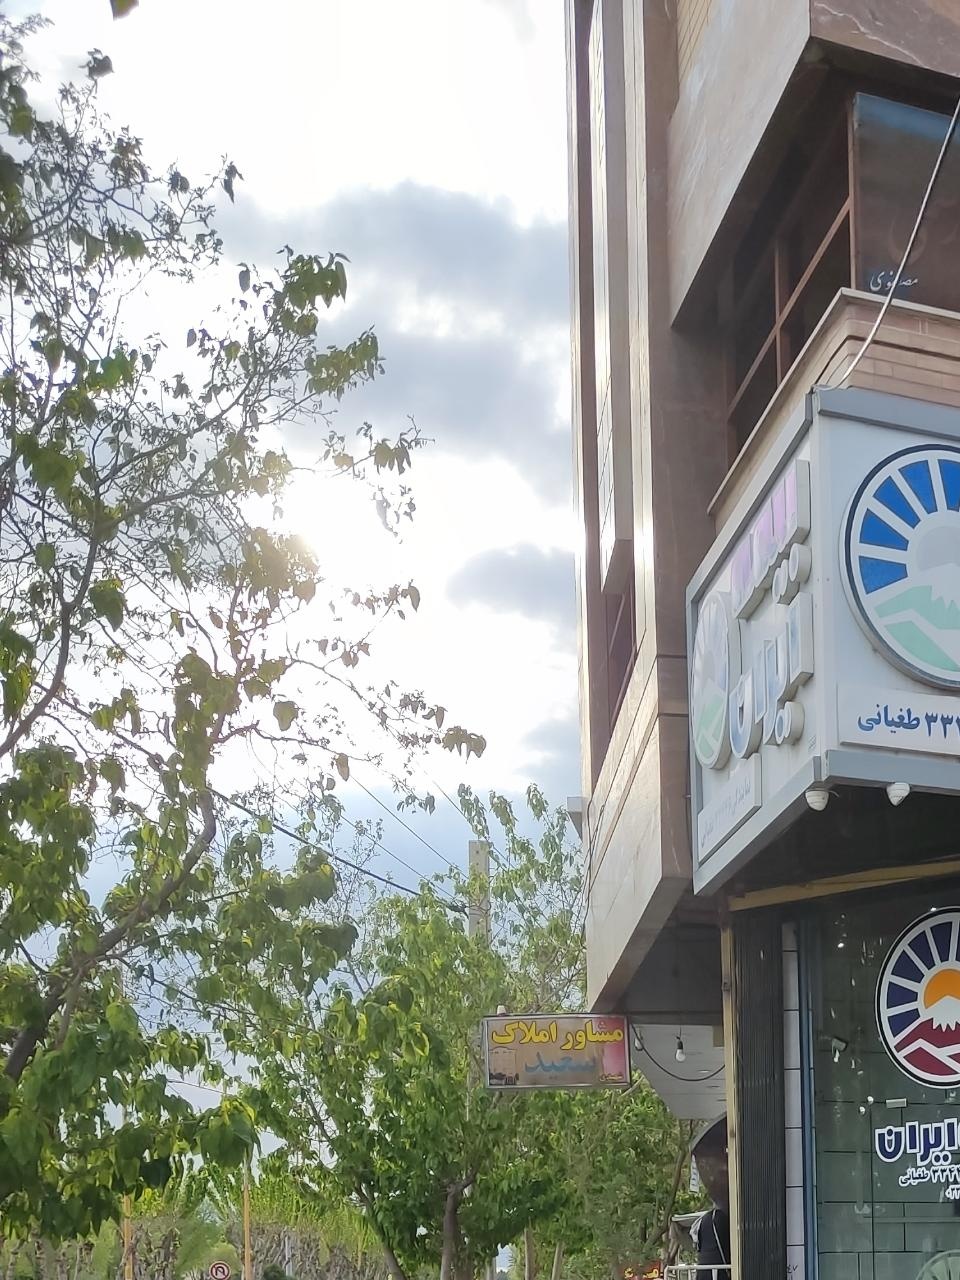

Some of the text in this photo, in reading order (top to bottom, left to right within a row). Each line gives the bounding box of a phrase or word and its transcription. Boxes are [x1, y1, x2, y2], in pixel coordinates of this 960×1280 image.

[858, 704, 920, 733] طغیانی
[492, 1020, 624, 1050] مشاور املاک
[524, 1052, 597, 1080] سعید
[875, 1118, 958, 1167] ایران
[899, 1166, 930, 1186] طغیانی
